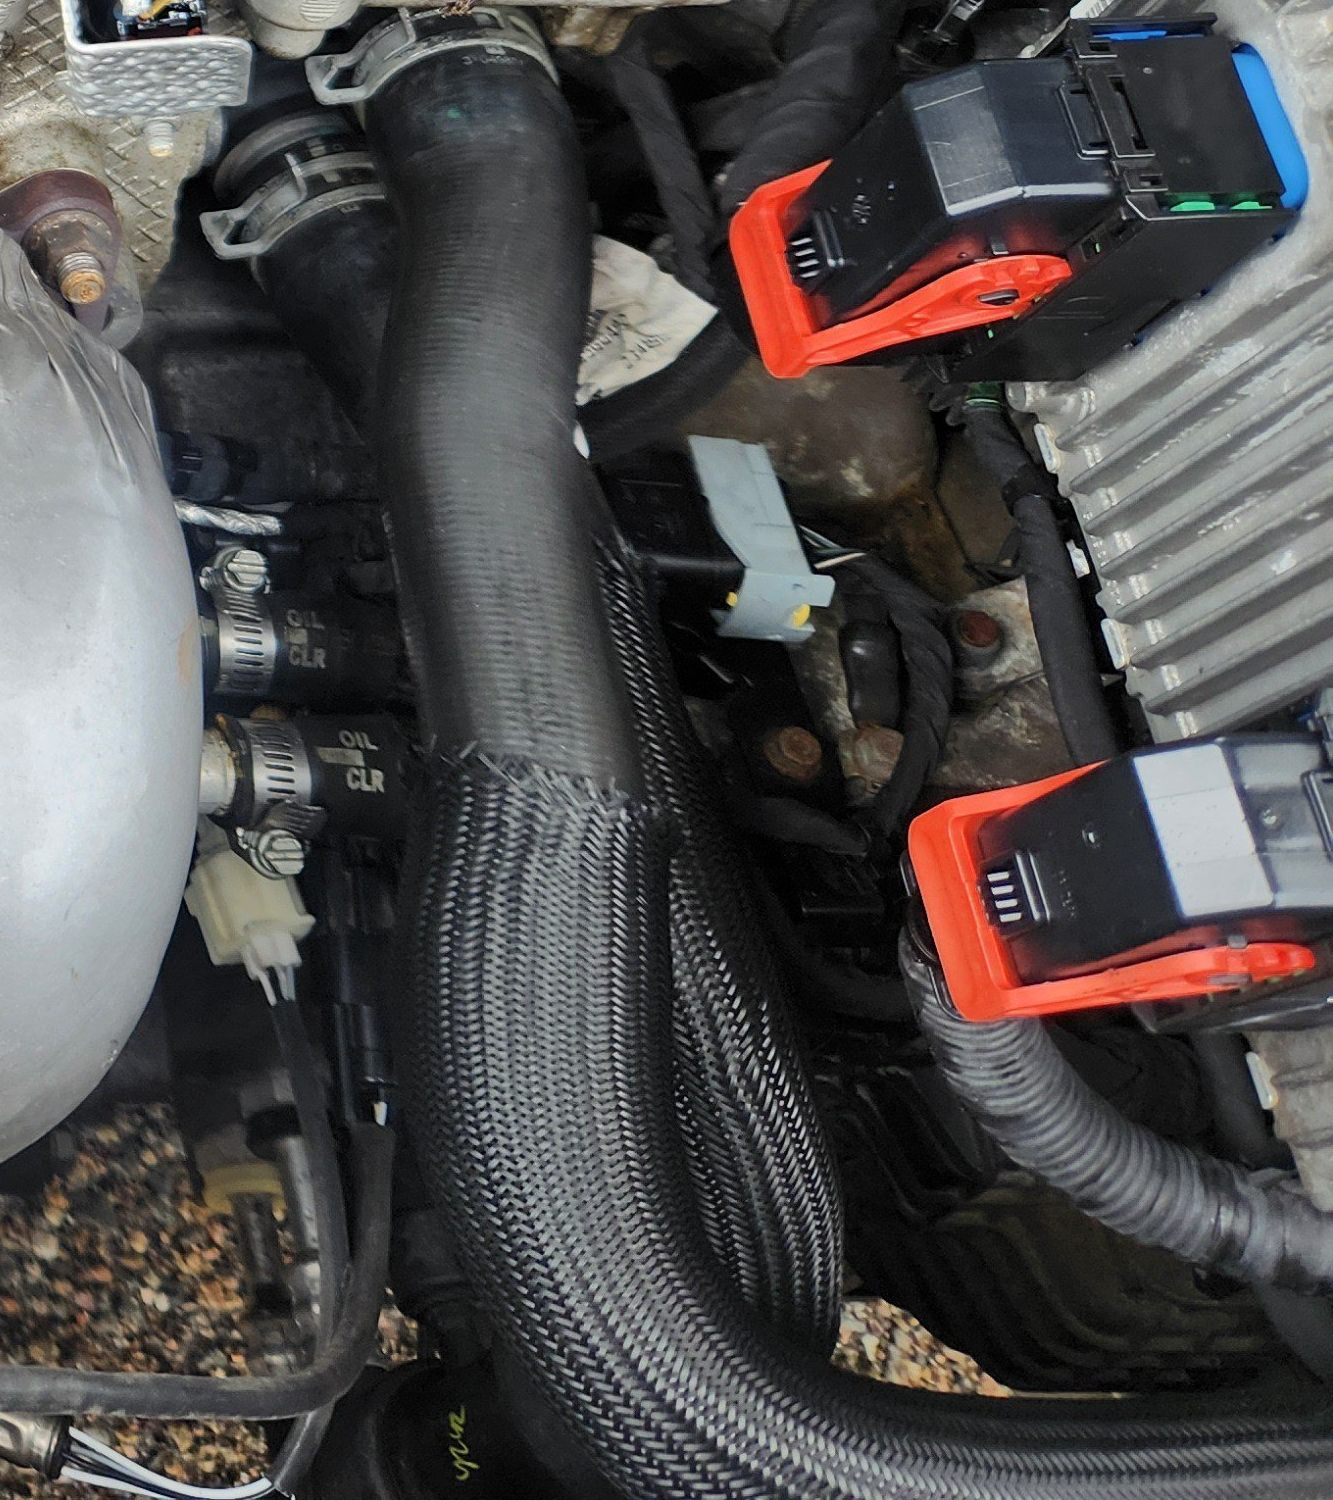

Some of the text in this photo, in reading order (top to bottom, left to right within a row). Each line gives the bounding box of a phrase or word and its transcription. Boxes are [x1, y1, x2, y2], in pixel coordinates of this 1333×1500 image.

[285, 608, 326, 630] OIL
[288, 645, 327, 670] CLR
[338, 729, 379, 752] OIL
[345, 766, 386, 794] CLR
